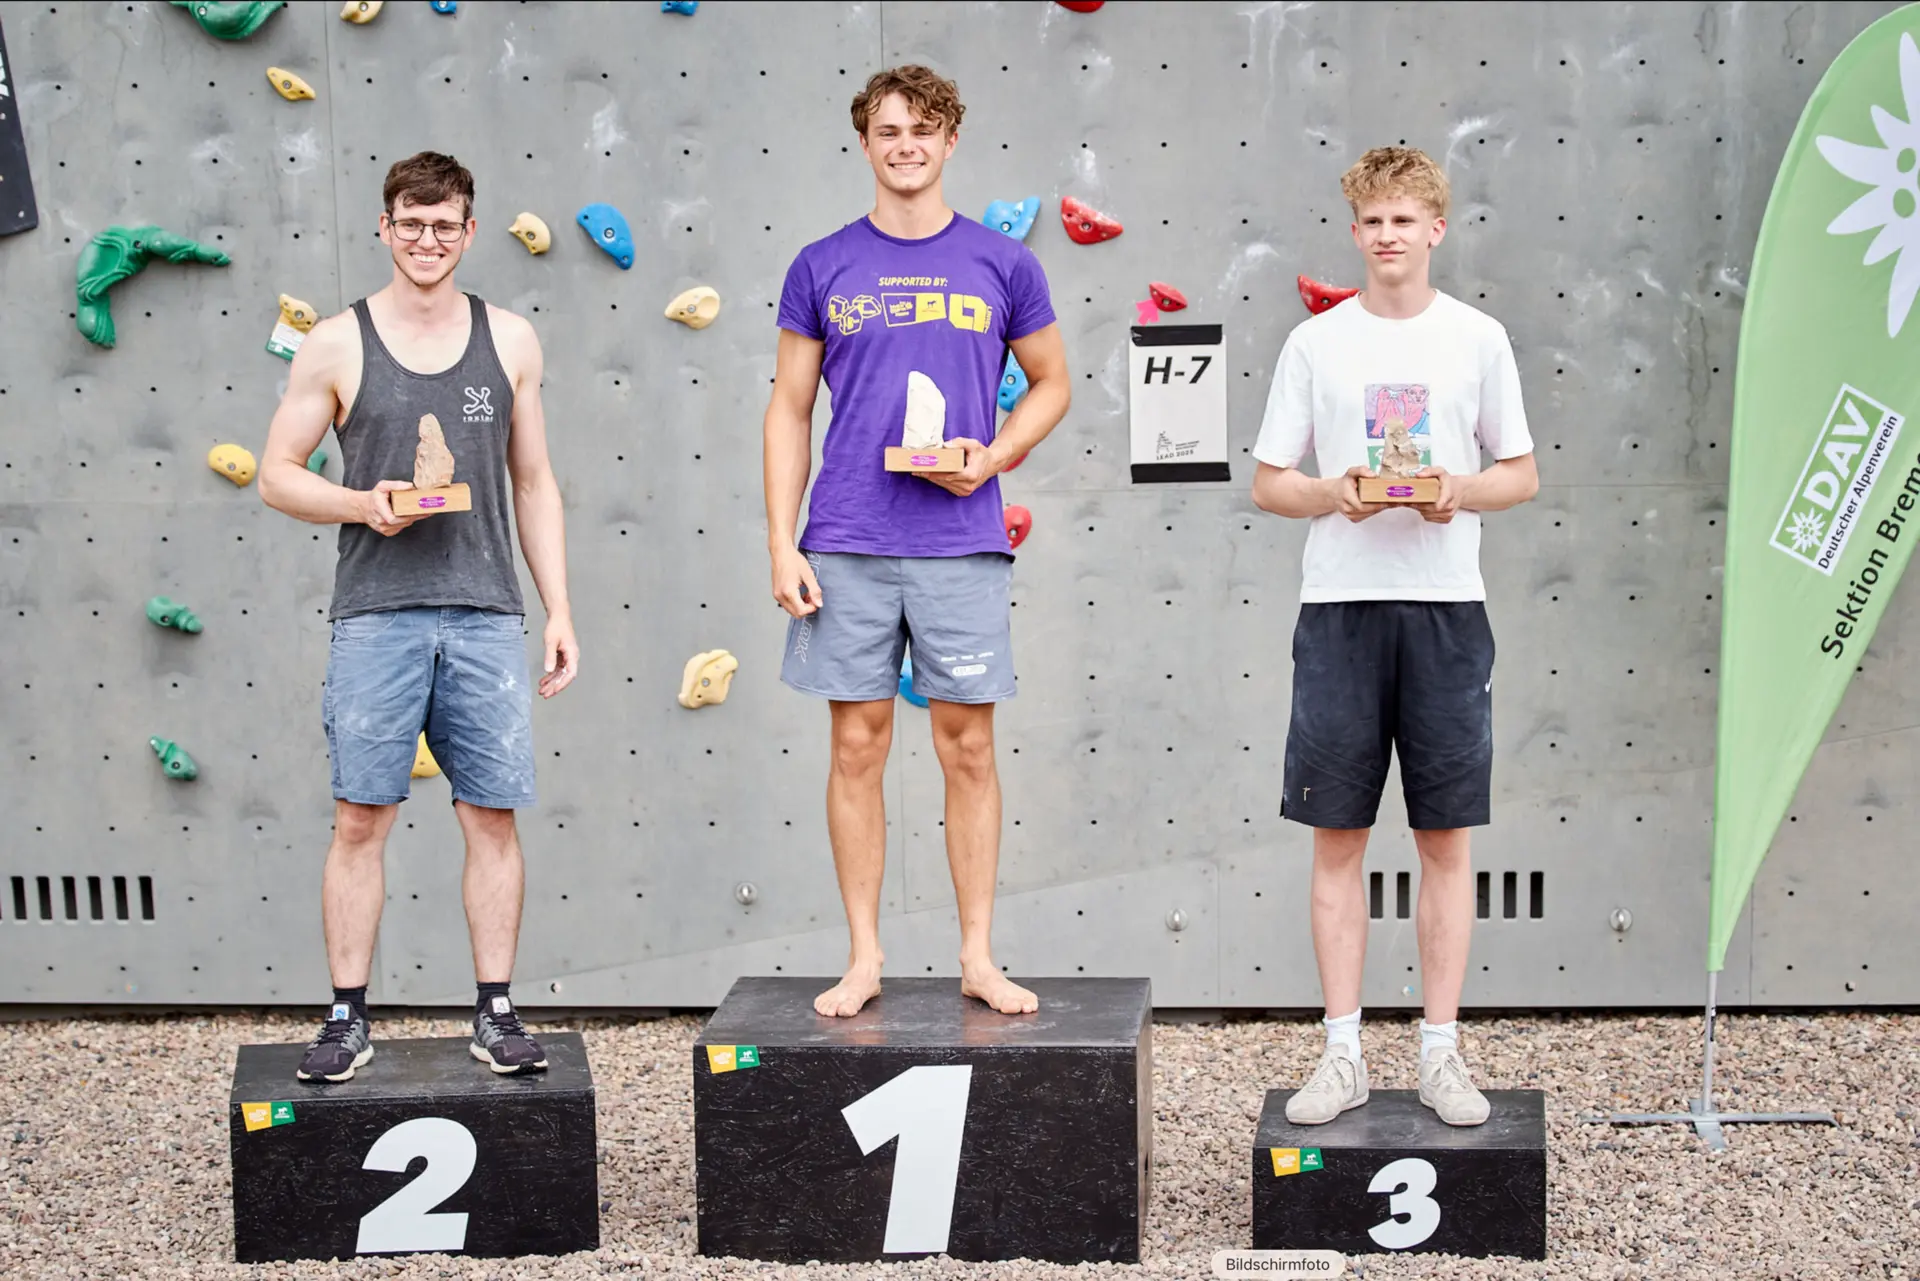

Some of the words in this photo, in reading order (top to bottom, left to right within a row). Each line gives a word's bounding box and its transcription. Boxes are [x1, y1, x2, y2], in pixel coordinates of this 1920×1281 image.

[878, 276, 931, 287] SUPPORTED
[933, 277, 948, 287] BY:
[1144, 356, 1212, 384] H-7
[1802, 399, 1870, 511] DAV
[1818, 499, 1857, 569] Deutscher
[1853, 415, 1897, 498] Alpenverein
[1821, 547, 1889, 659] Sektion
[356, 1117, 478, 1254] 2
[841, 1064, 973, 1254] 1
[1366, 1157, 1442, 1250] 3
